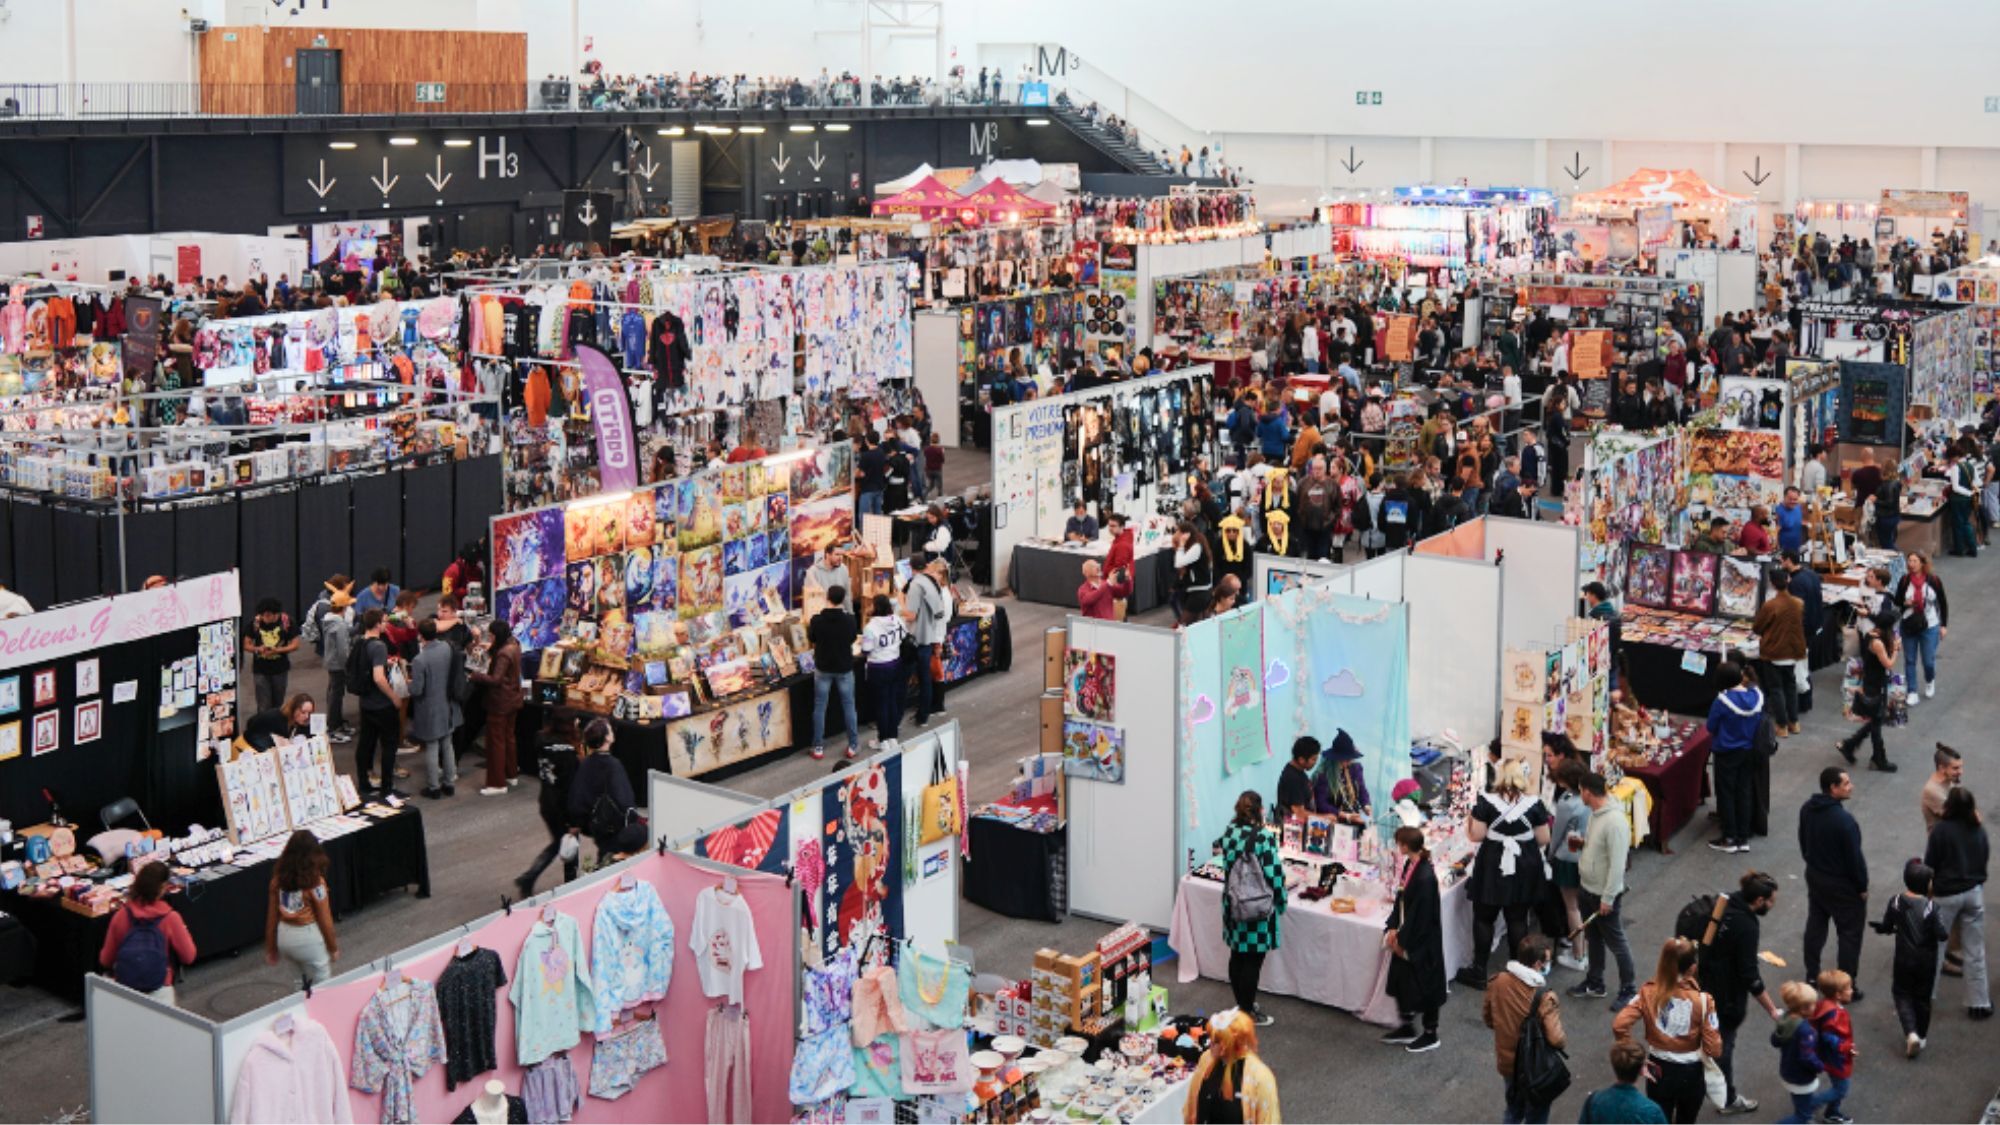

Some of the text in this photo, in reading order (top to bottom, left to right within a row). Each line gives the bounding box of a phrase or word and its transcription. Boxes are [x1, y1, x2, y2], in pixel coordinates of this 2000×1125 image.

[1038, 46, 1080, 76] M3
[970, 122, 998, 155] M3
[479, 136, 518, 179] H3
